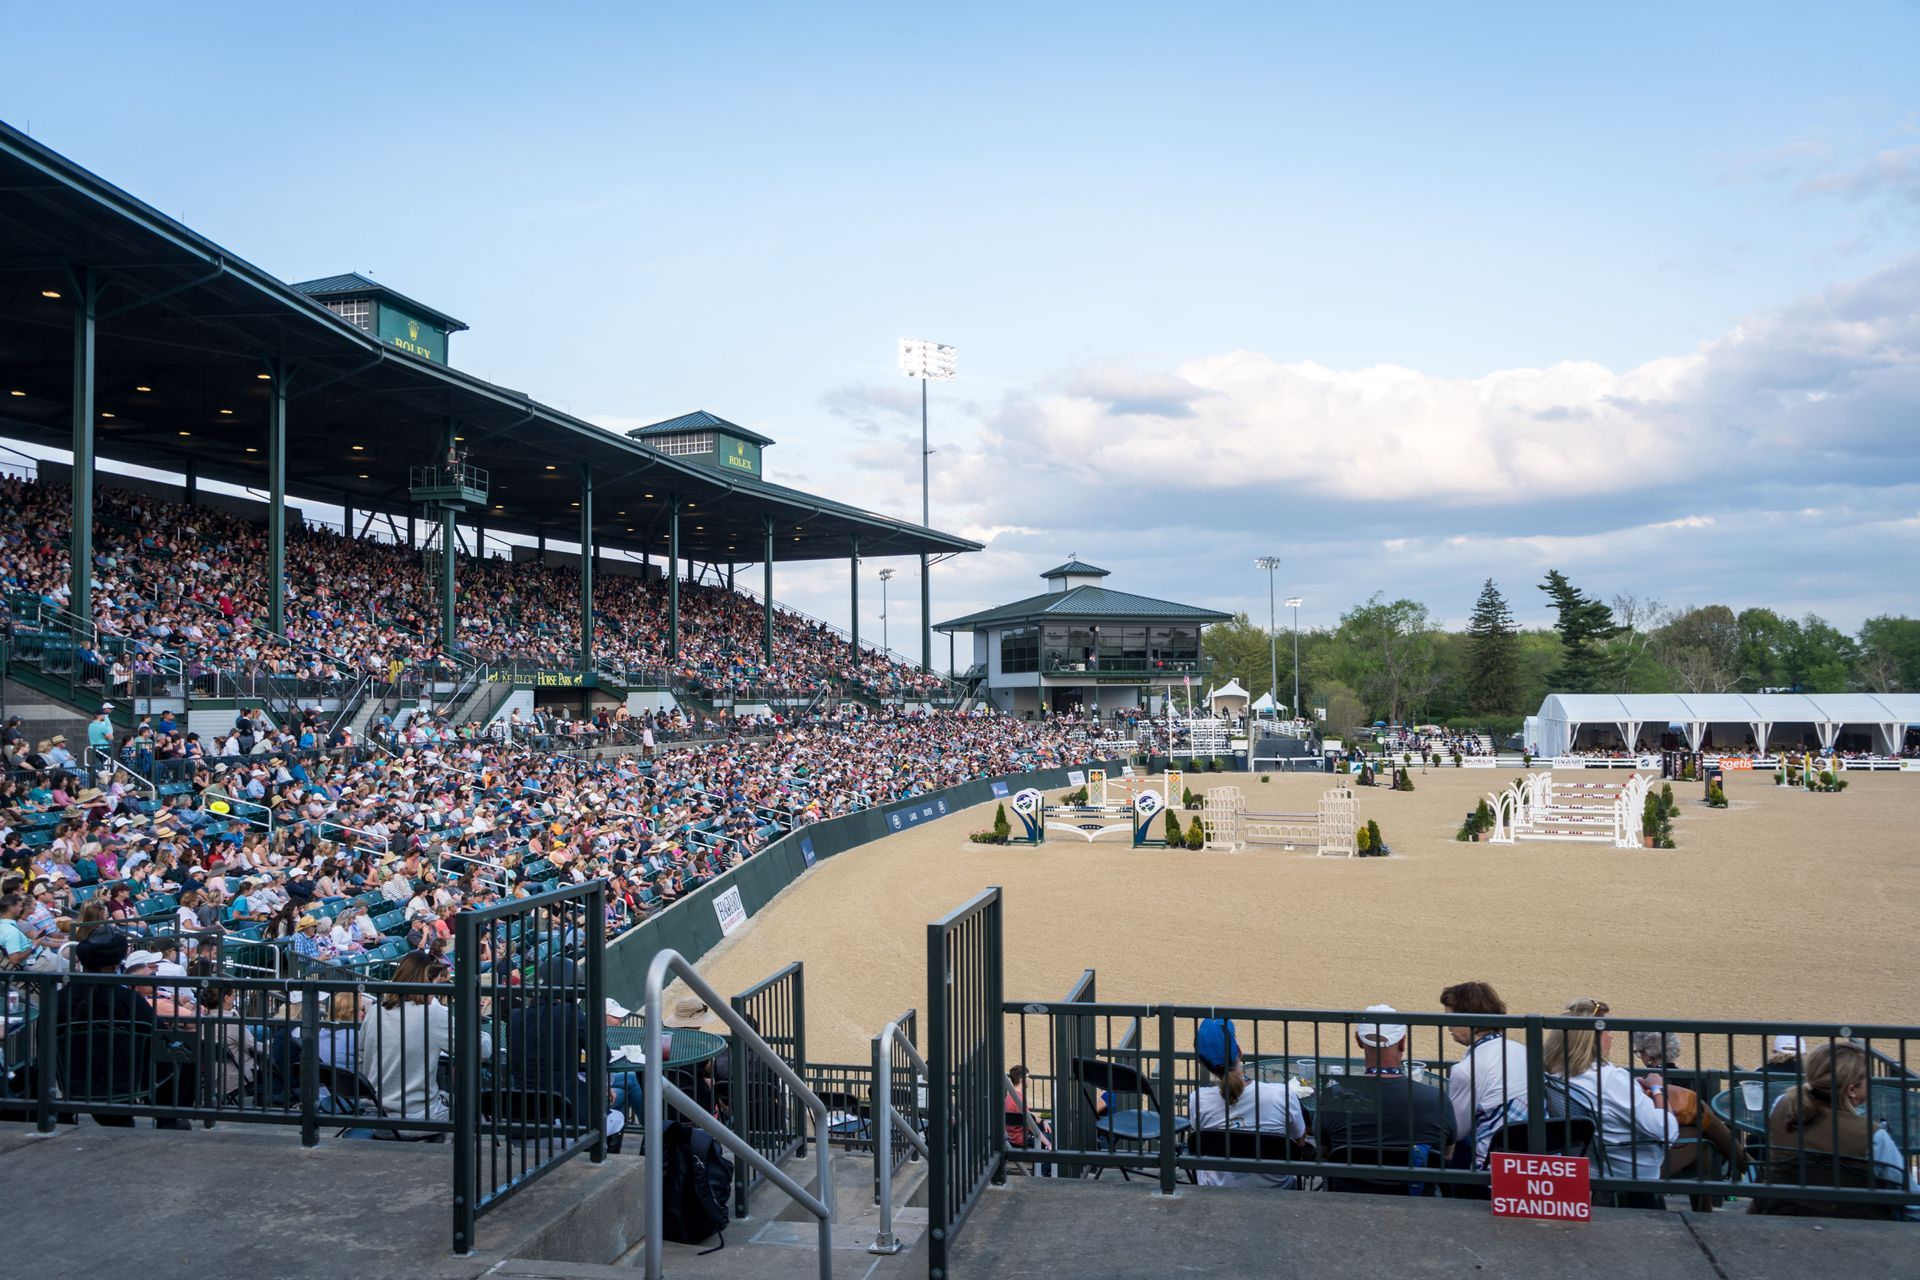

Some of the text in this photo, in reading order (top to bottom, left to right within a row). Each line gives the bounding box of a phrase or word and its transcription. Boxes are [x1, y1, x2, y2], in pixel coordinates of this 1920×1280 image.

[729, 455, 752, 470] ROLEX
[537, 672, 557, 686] HORSE
[558, 672, 573, 686] PARK
[1720, 760, 1752, 769] zoetis
[1504, 1158, 1577, 1177] PLEASE
[1527, 1180, 1554, 1196] NO
[1493, 1197, 1589, 1218] STANDING
